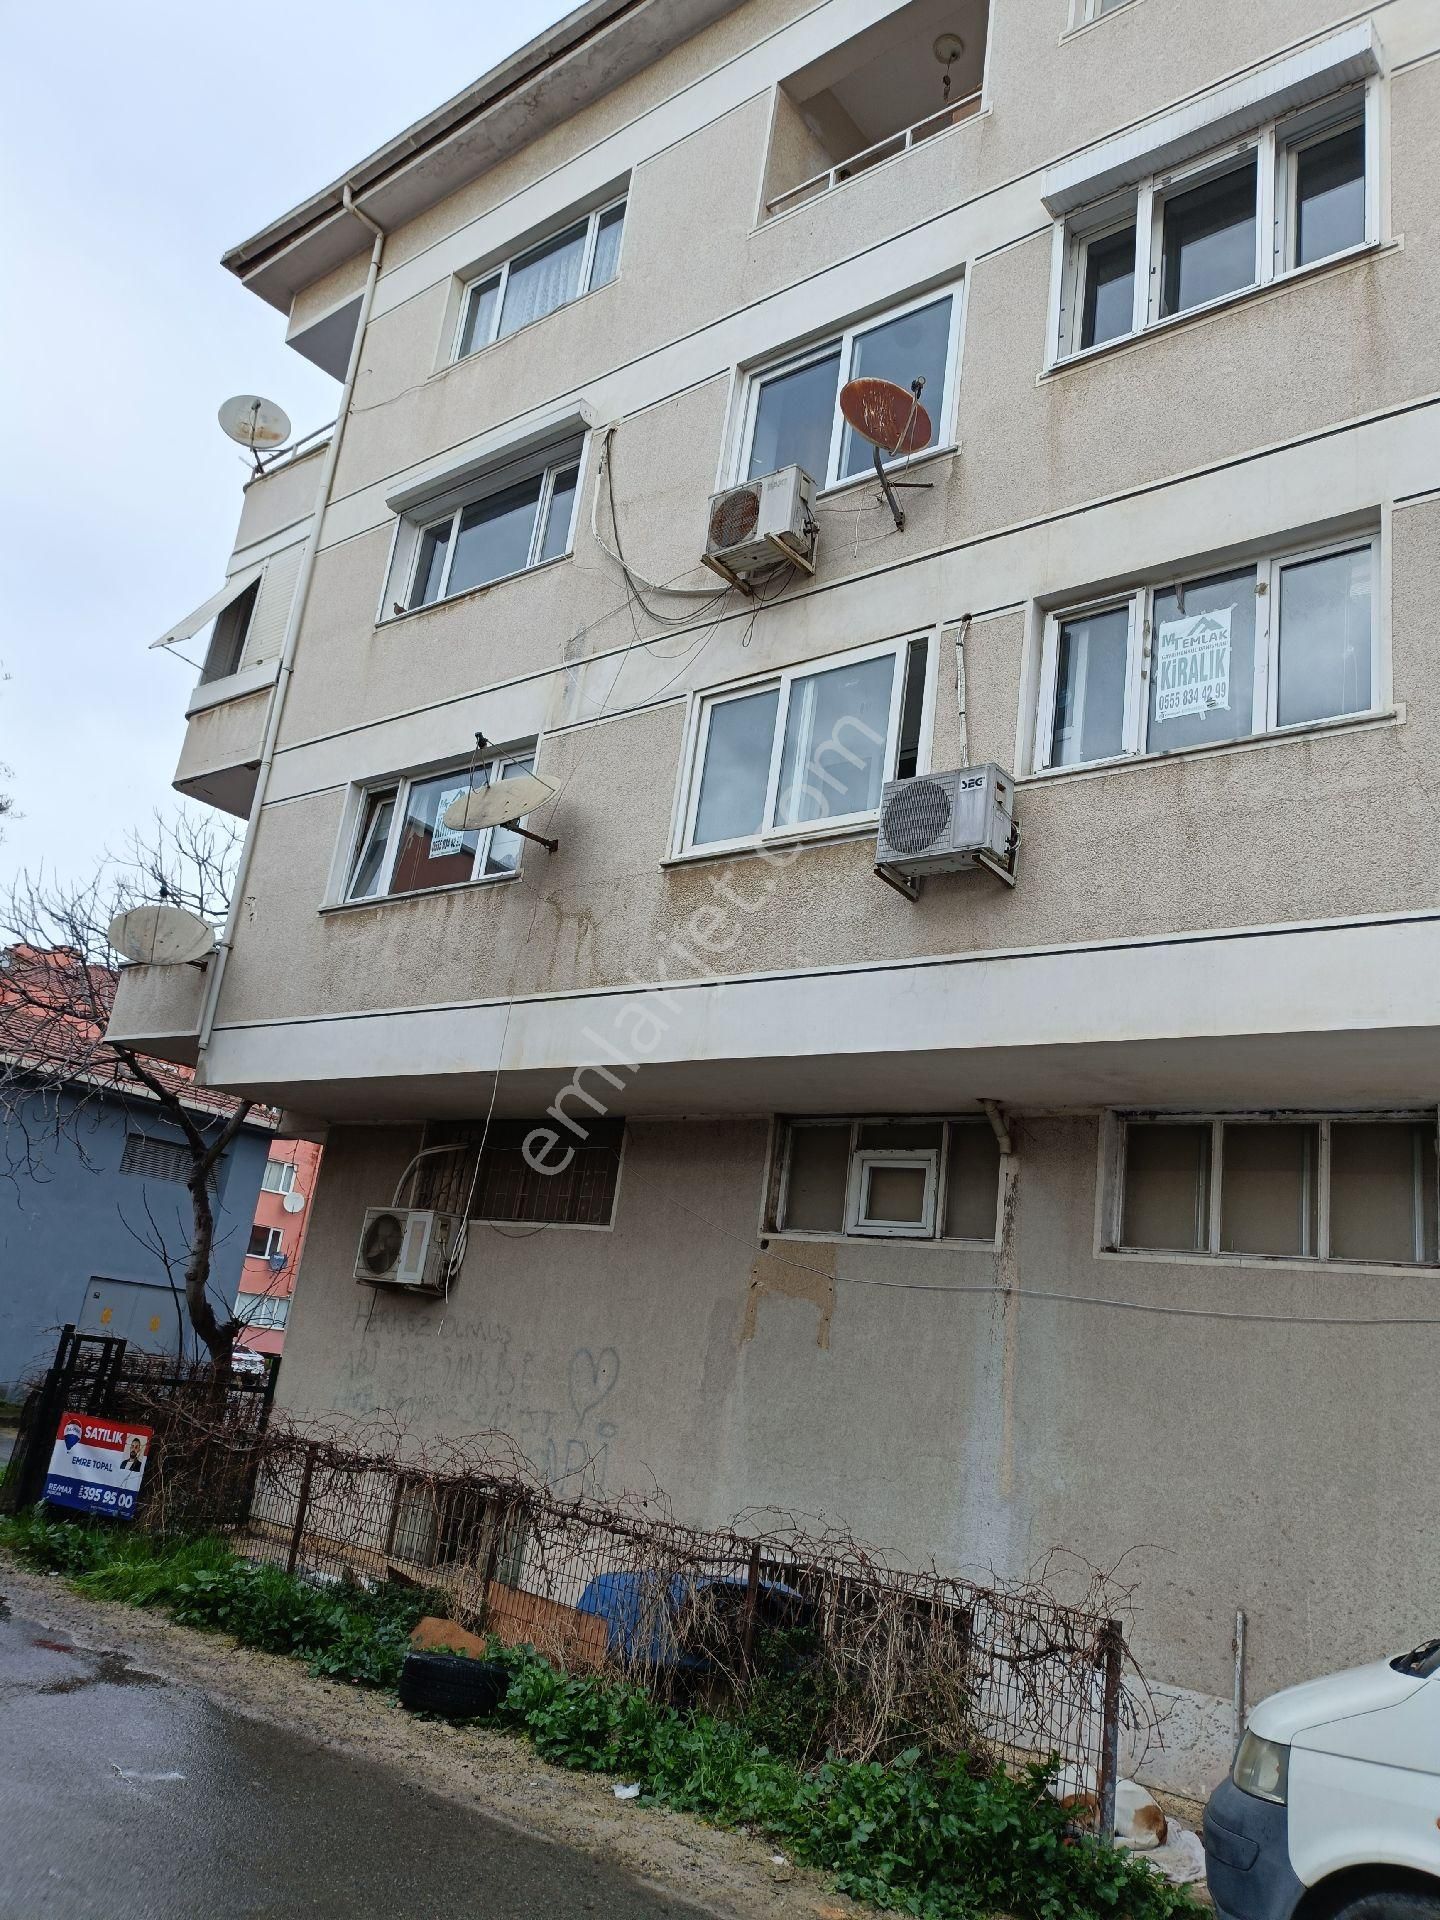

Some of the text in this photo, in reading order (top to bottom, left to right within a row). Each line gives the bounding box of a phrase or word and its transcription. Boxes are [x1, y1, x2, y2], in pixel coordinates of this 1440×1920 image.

[1183, 629, 1228, 649] EMLAK
[1160, 648, 1227, 691] KİRALIK
[1159, 692, 1180, 710] 0555
[1202, 684, 1213, 701] 42
[1215, 681, 1227, 698] 99
[84, 1425, 125, 1444] SATILIK
[71, 1456, 113, 1472] EMRE TOPAL
[48, 1482, 73, 1495] RE/MAX
[83, 1486, 102, 1502] 395
[102, 1490, 117, 1505] 95
[118, 1493, 133, 1509] 00
